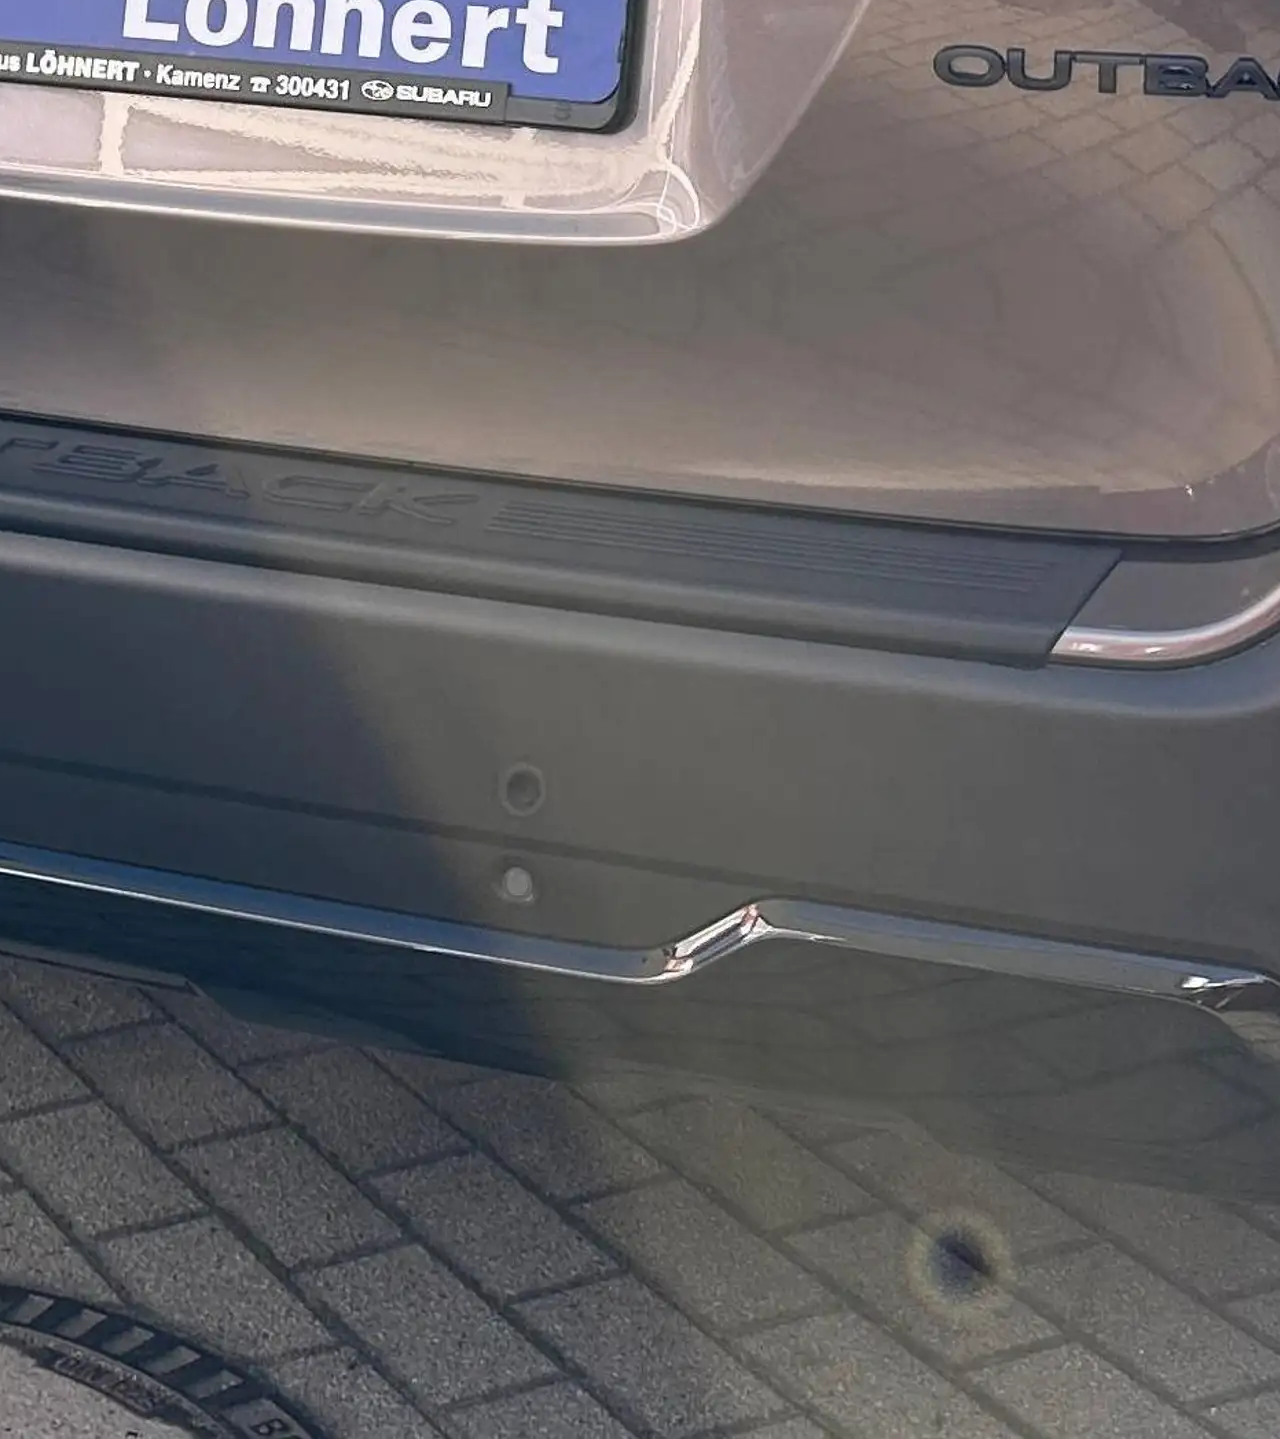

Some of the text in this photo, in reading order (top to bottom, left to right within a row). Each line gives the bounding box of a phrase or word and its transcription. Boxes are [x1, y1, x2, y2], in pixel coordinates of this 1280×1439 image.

[26, 49, 140, 81] LÖHNERT
[156, 63, 240, 91] Kamenz
[275, 73, 350, 100] 300431
[395, 85, 491, 108] SUBARU
